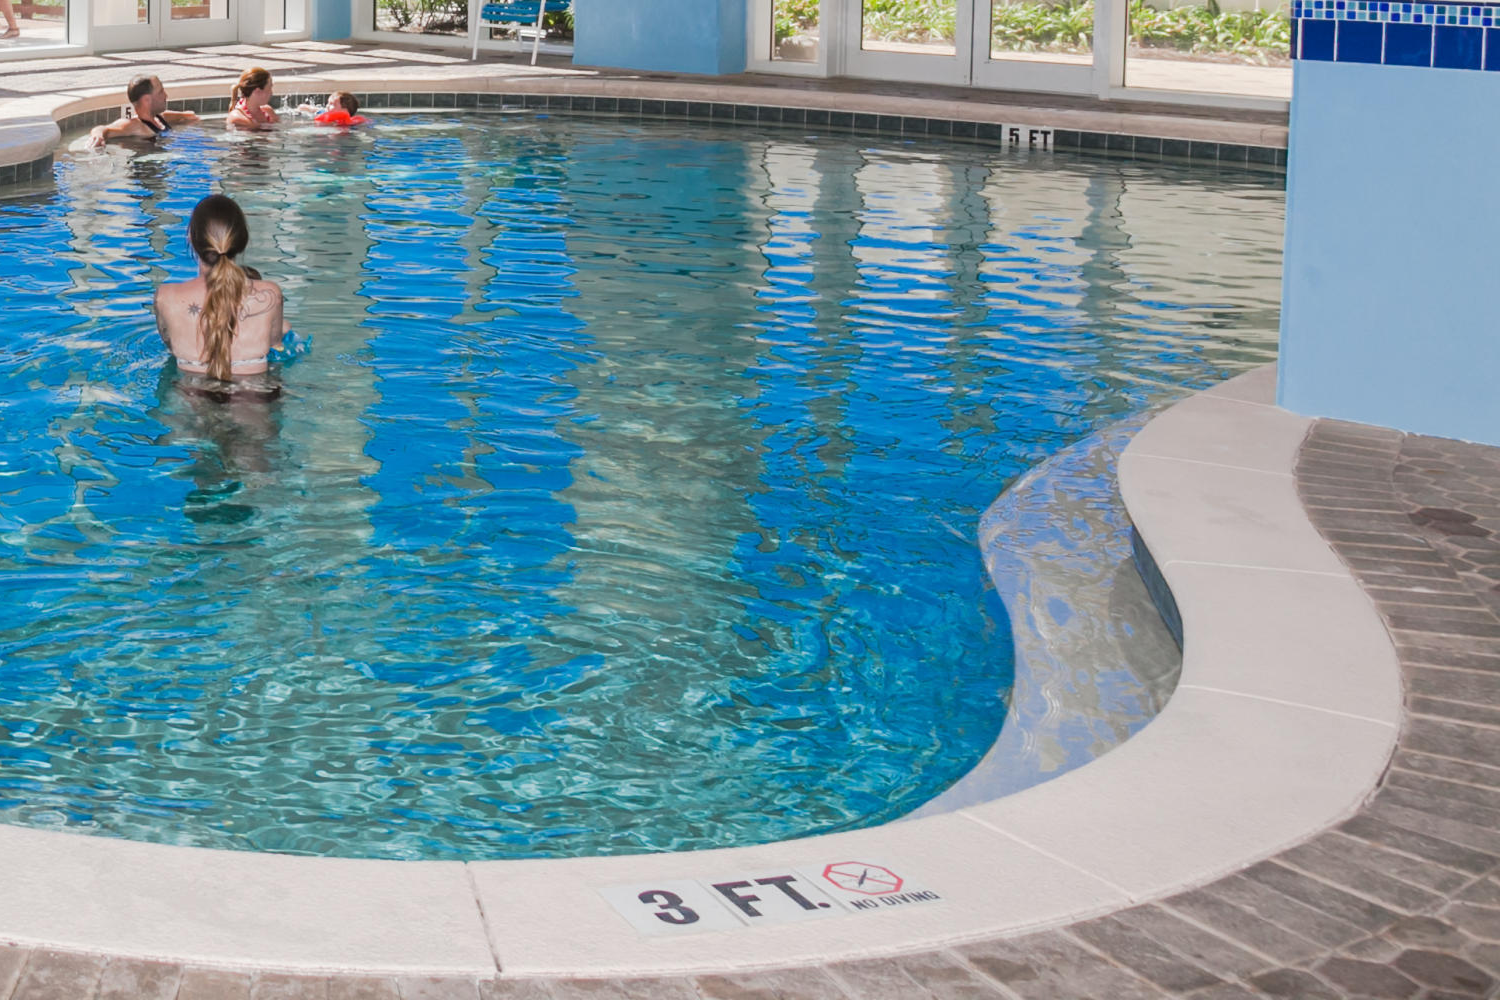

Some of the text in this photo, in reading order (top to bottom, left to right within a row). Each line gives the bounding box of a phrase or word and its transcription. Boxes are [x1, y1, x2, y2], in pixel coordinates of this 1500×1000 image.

[125, 106, 132, 119] 5
[1009, 127, 1051, 145] 5 FT
[637, 874, 831, 925] 3 FT.
[850, 890, 941, 911] NO DIVING
